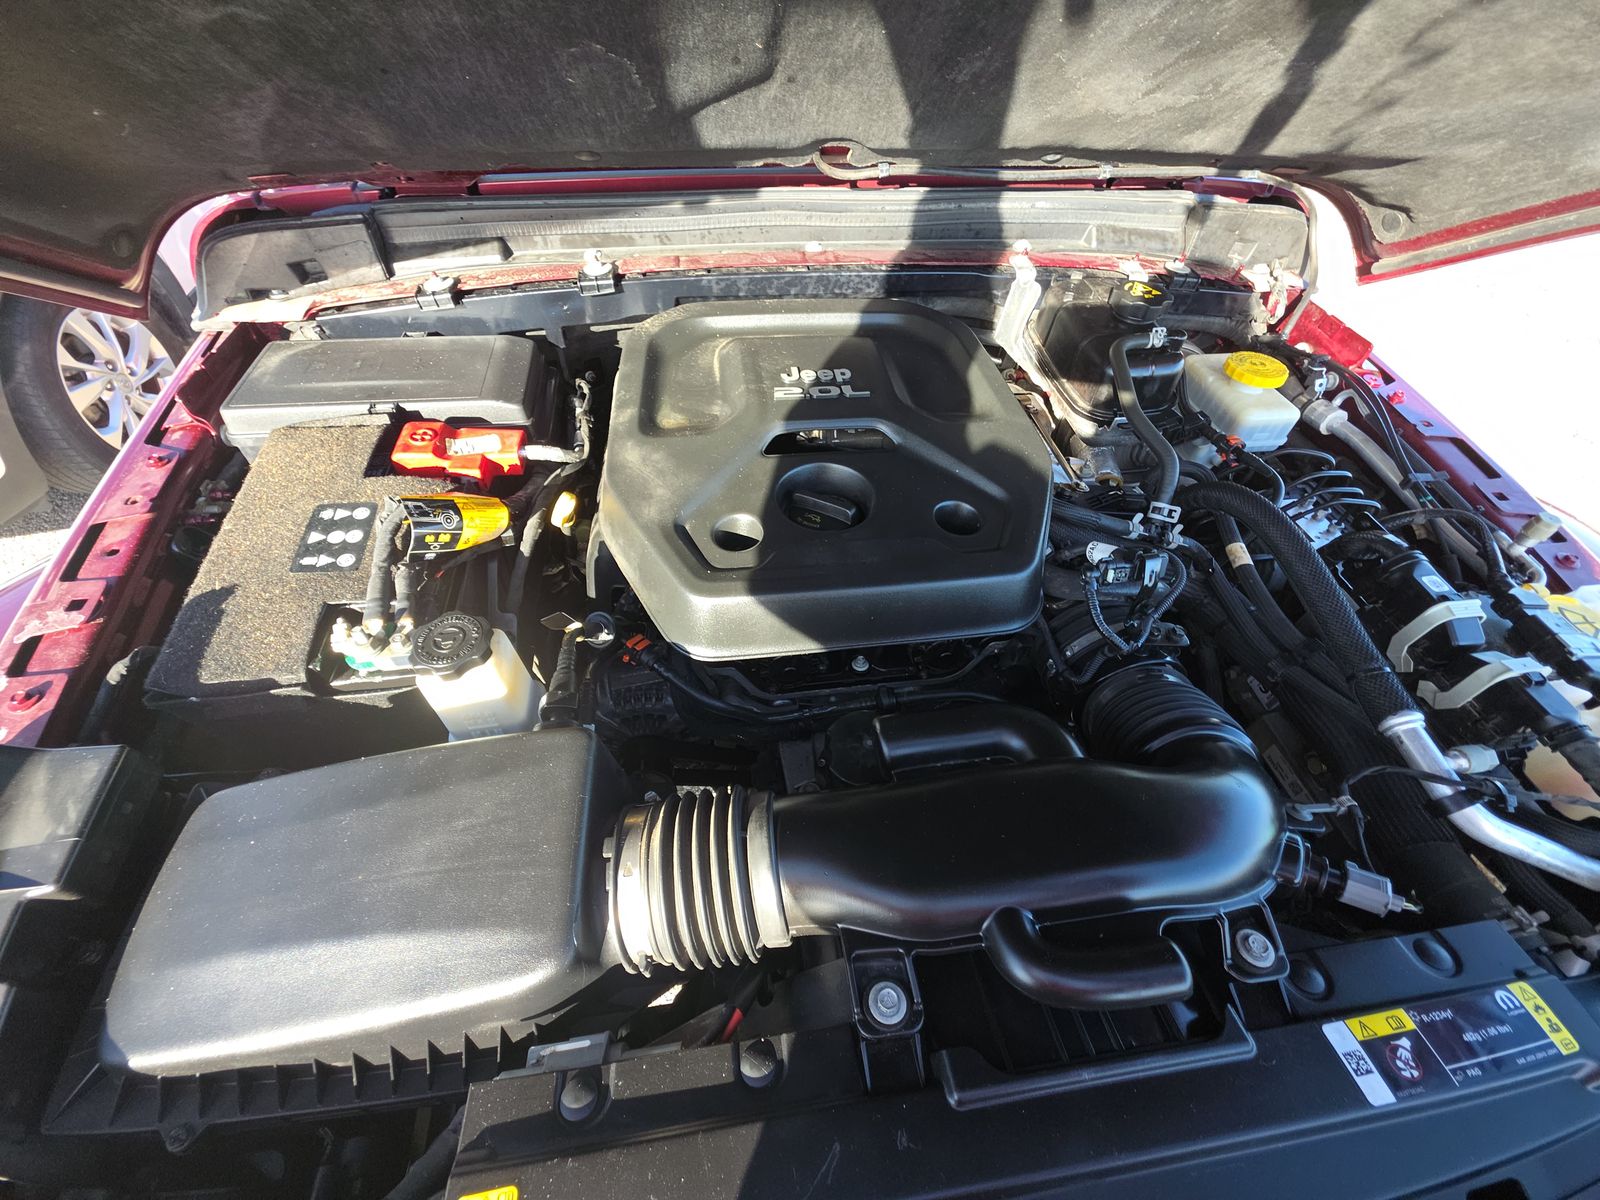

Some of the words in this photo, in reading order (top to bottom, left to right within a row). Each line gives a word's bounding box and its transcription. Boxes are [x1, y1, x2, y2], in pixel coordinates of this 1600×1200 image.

[779, 366, 852, 384] Jeep
[774, 385, 871, 401] 2.0L
[1421, 1009, 1454, 1023] R-1234yf
